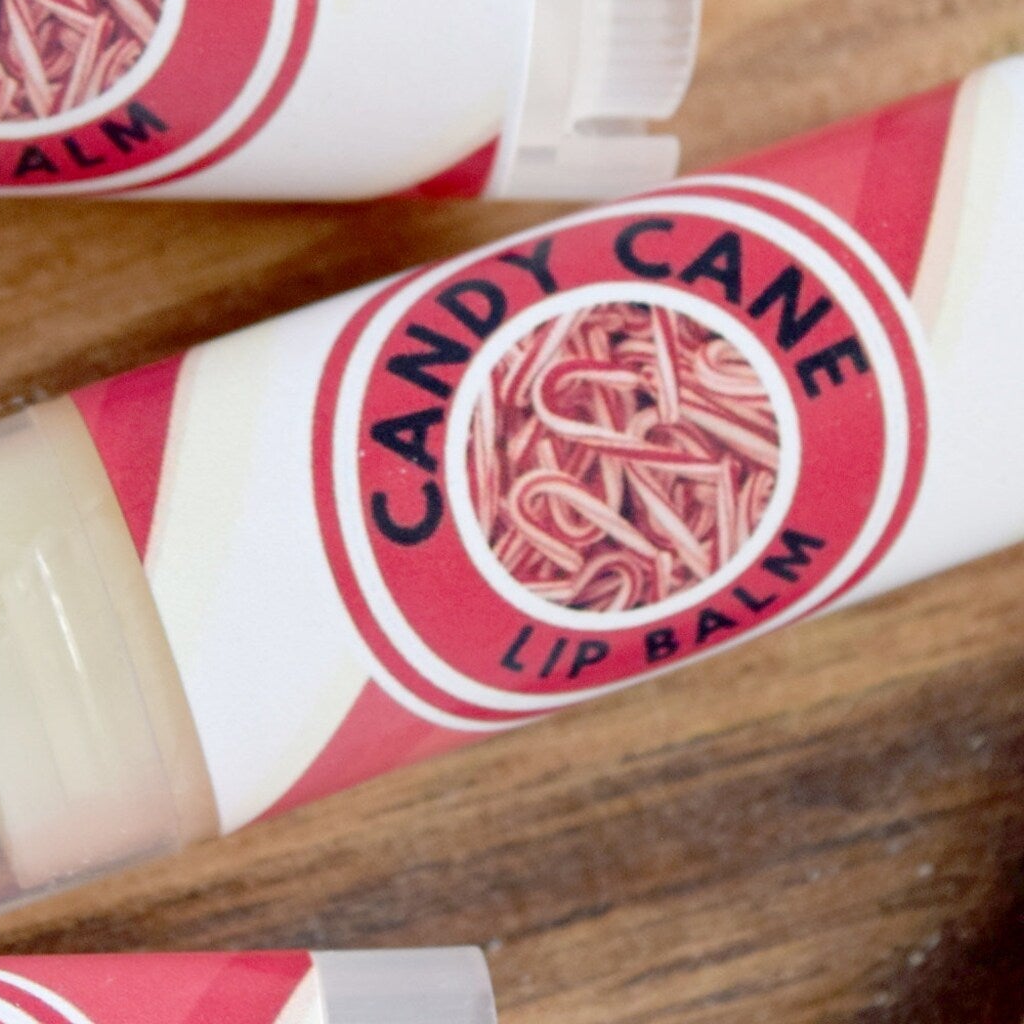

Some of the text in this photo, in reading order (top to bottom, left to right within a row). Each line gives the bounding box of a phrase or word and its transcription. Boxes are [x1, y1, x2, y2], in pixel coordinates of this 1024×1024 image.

[370, 218, 870, 546] CANDY CANE
[500, 529, 826, 679] LIP BALM
